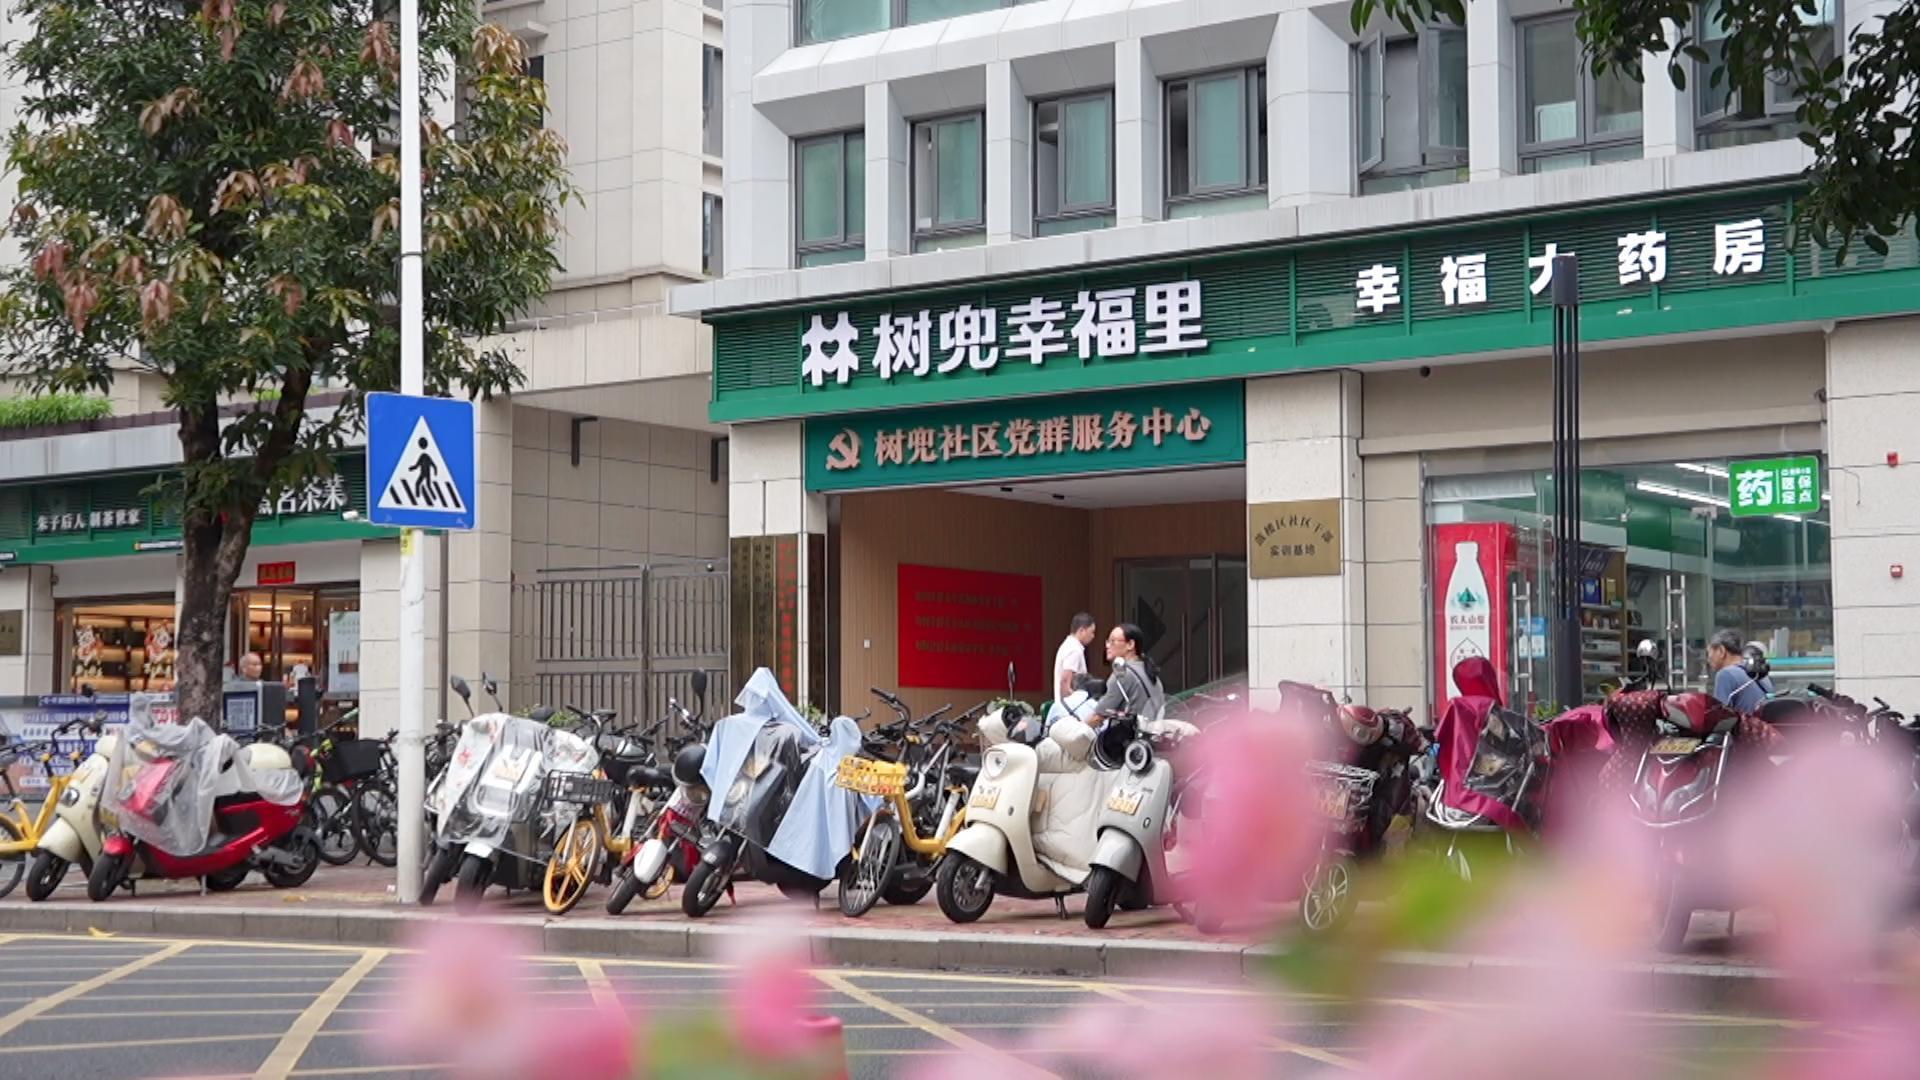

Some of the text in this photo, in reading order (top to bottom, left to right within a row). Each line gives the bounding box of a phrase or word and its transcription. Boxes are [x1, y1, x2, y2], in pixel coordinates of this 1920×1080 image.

[1356, 218, 1766, 313] 幸福大药房
[872, 280, 1208, 380] 树兜幸福里
[873, 406, 1212, 467] 树兜社区党群服务中心
[1736, 469, 1773, 507] 药
